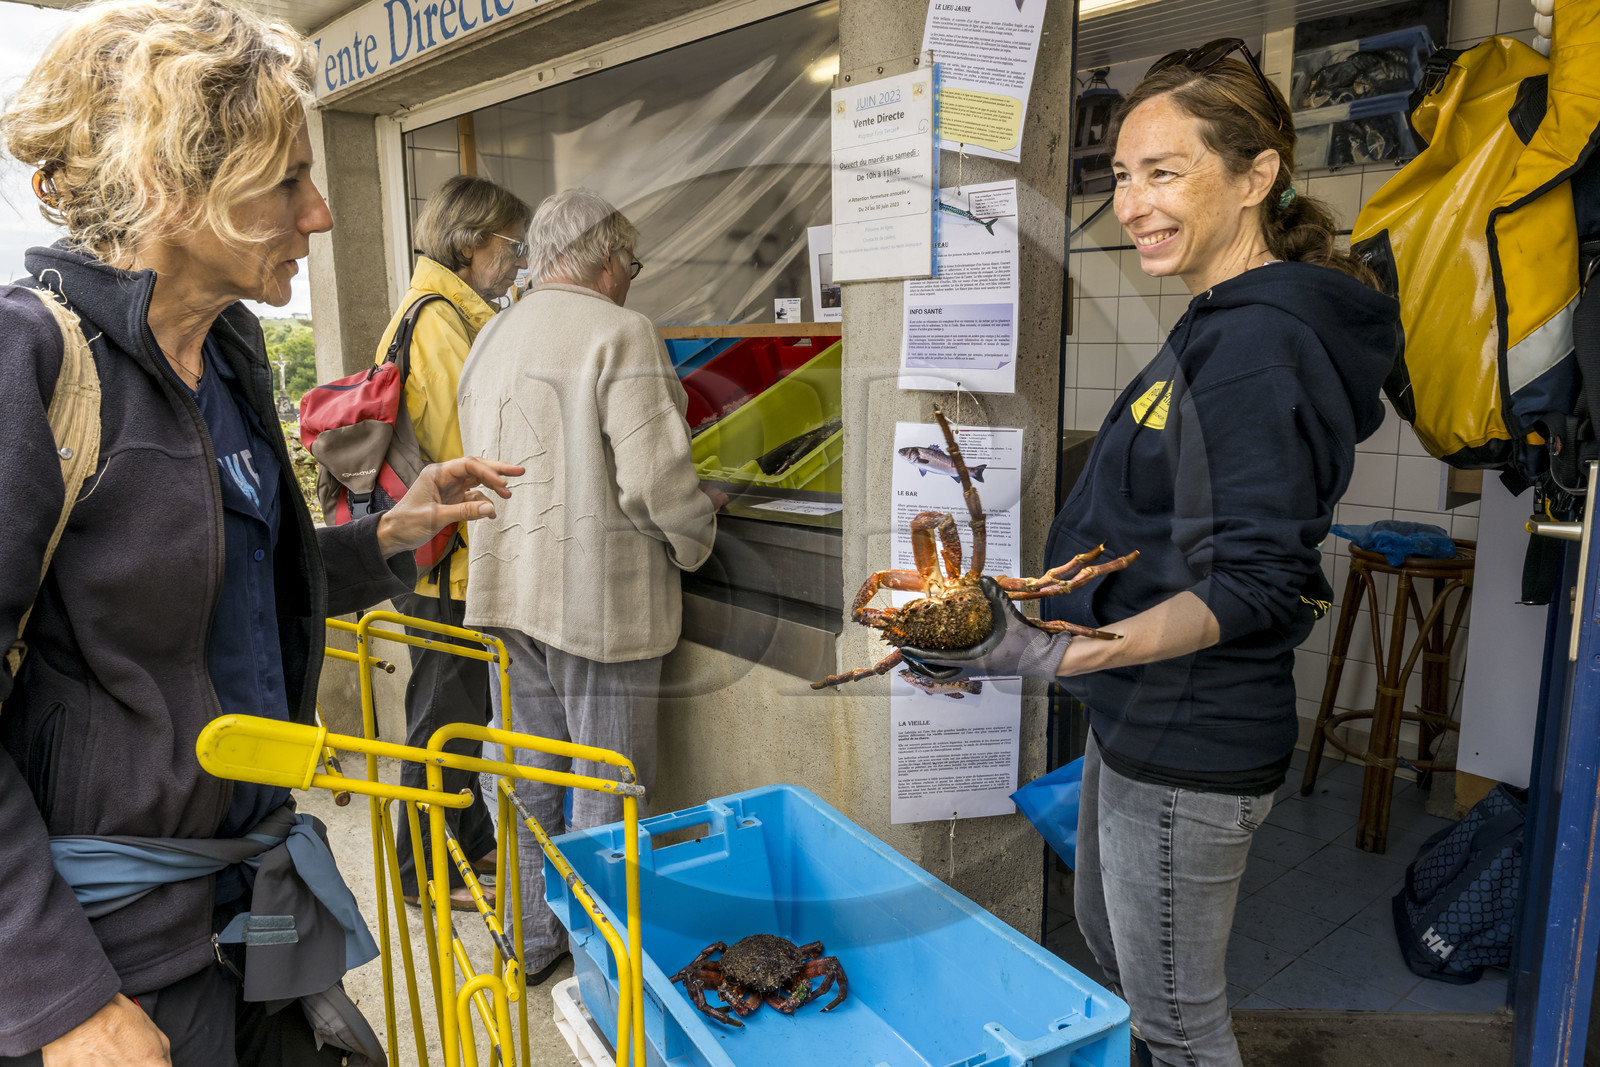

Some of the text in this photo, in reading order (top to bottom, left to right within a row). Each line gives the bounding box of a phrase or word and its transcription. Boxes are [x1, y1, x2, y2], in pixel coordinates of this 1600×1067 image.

[315, 31, 378, 98] ente
[856, 89, 901, 110] JUIN 2023
[853, 111, 905, 128] Vente Directe
[839, 160, 858, 169] Ouvert
[860, 158, 866, 166] du
[868, 155, 885, 164] mardi
[894, 149, 916, 158] samedi
[866, 172, 876, 180] 10h
[883, 167, 900, 177] 11h45
[923, 307, 943, 315] SANTÉ
[1422, 926, 1454, 959] HH
